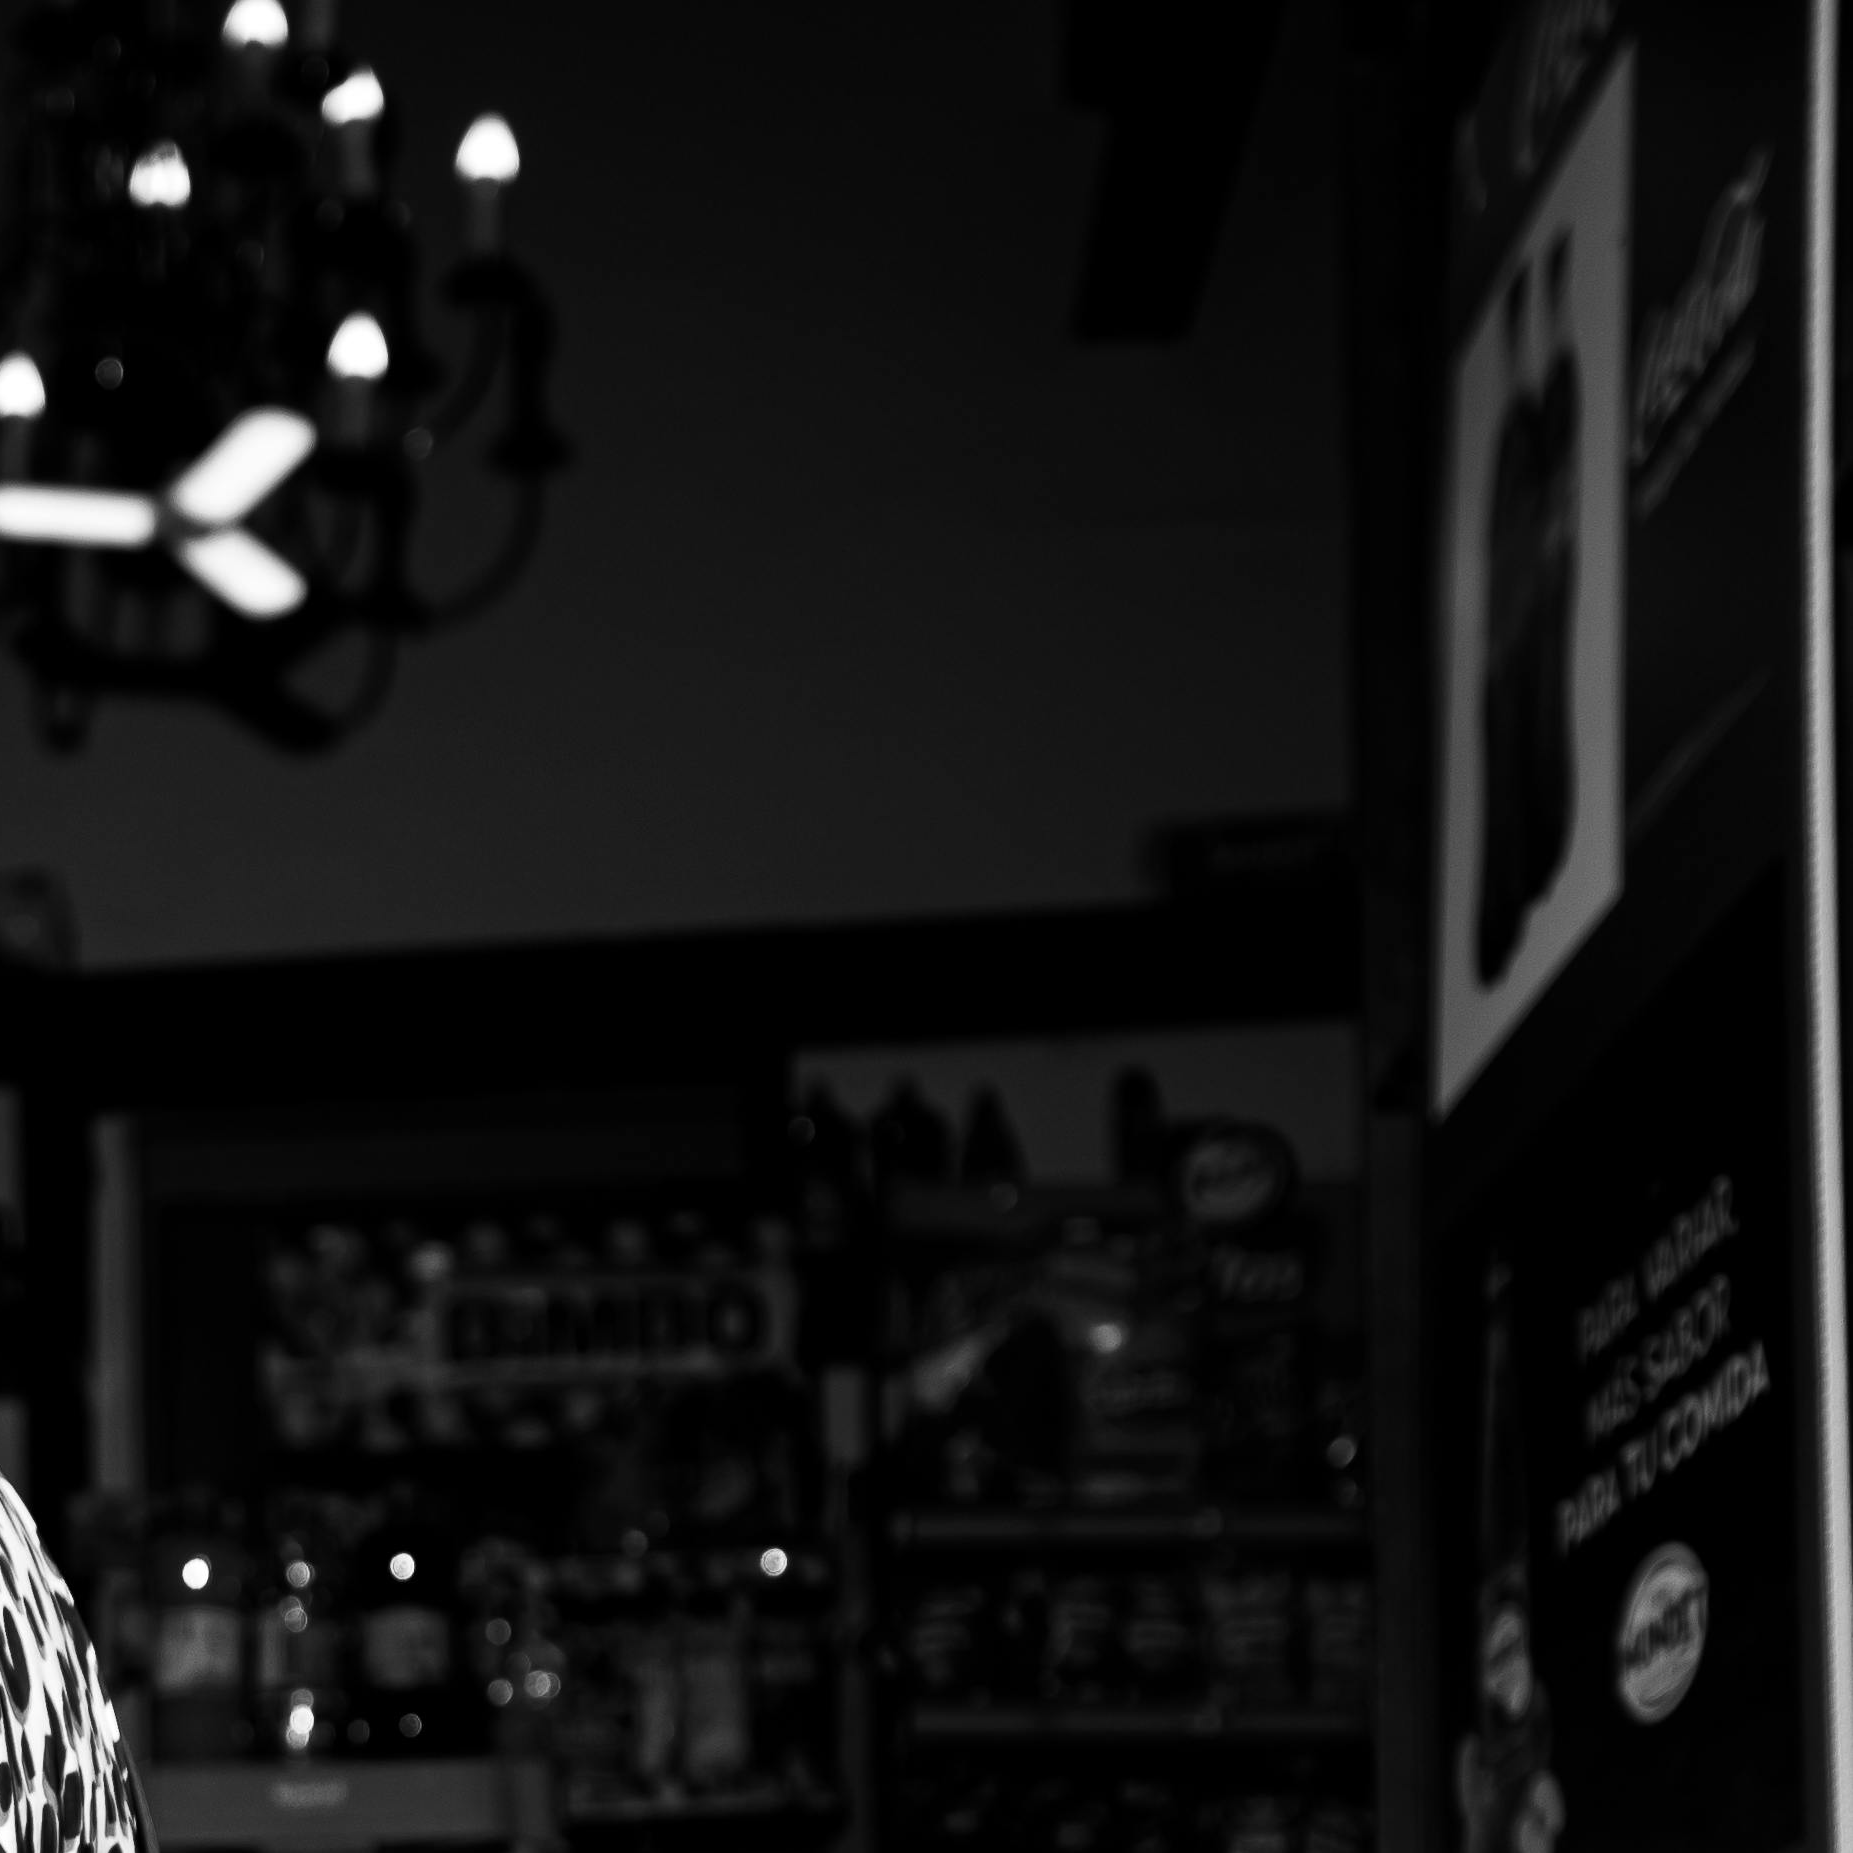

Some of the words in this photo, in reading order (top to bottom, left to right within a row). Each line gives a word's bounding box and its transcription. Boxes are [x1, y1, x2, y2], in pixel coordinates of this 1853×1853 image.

[1642, 1273, 1730, 1402] SABOR
[1558, 1468, 1622, 1555] PARA
[1621, 1431, 1658, 1495] TU
[1661, 1340, 1770, 1472] COMIDA
